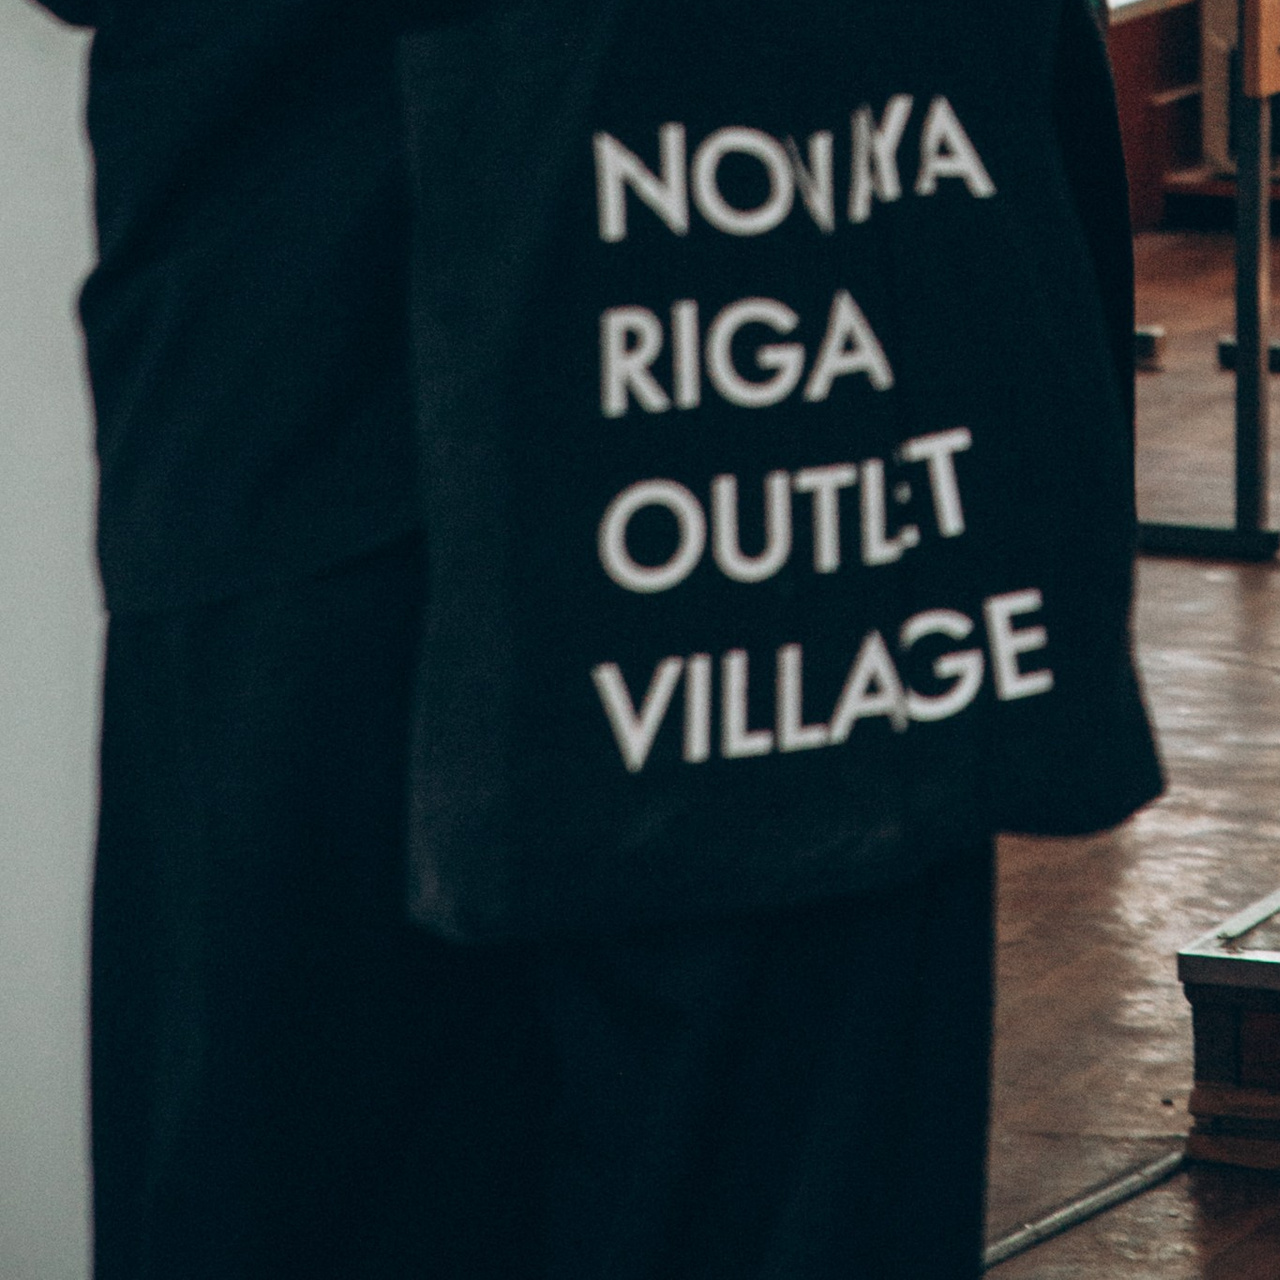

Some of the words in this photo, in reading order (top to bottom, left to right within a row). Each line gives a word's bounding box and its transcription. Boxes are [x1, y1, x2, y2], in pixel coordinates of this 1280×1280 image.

[601, 291, 894, 418] RIGA
[599, 427, 972, 593] OUTLT
[592, 588, 1054, 772] VILLAGE
